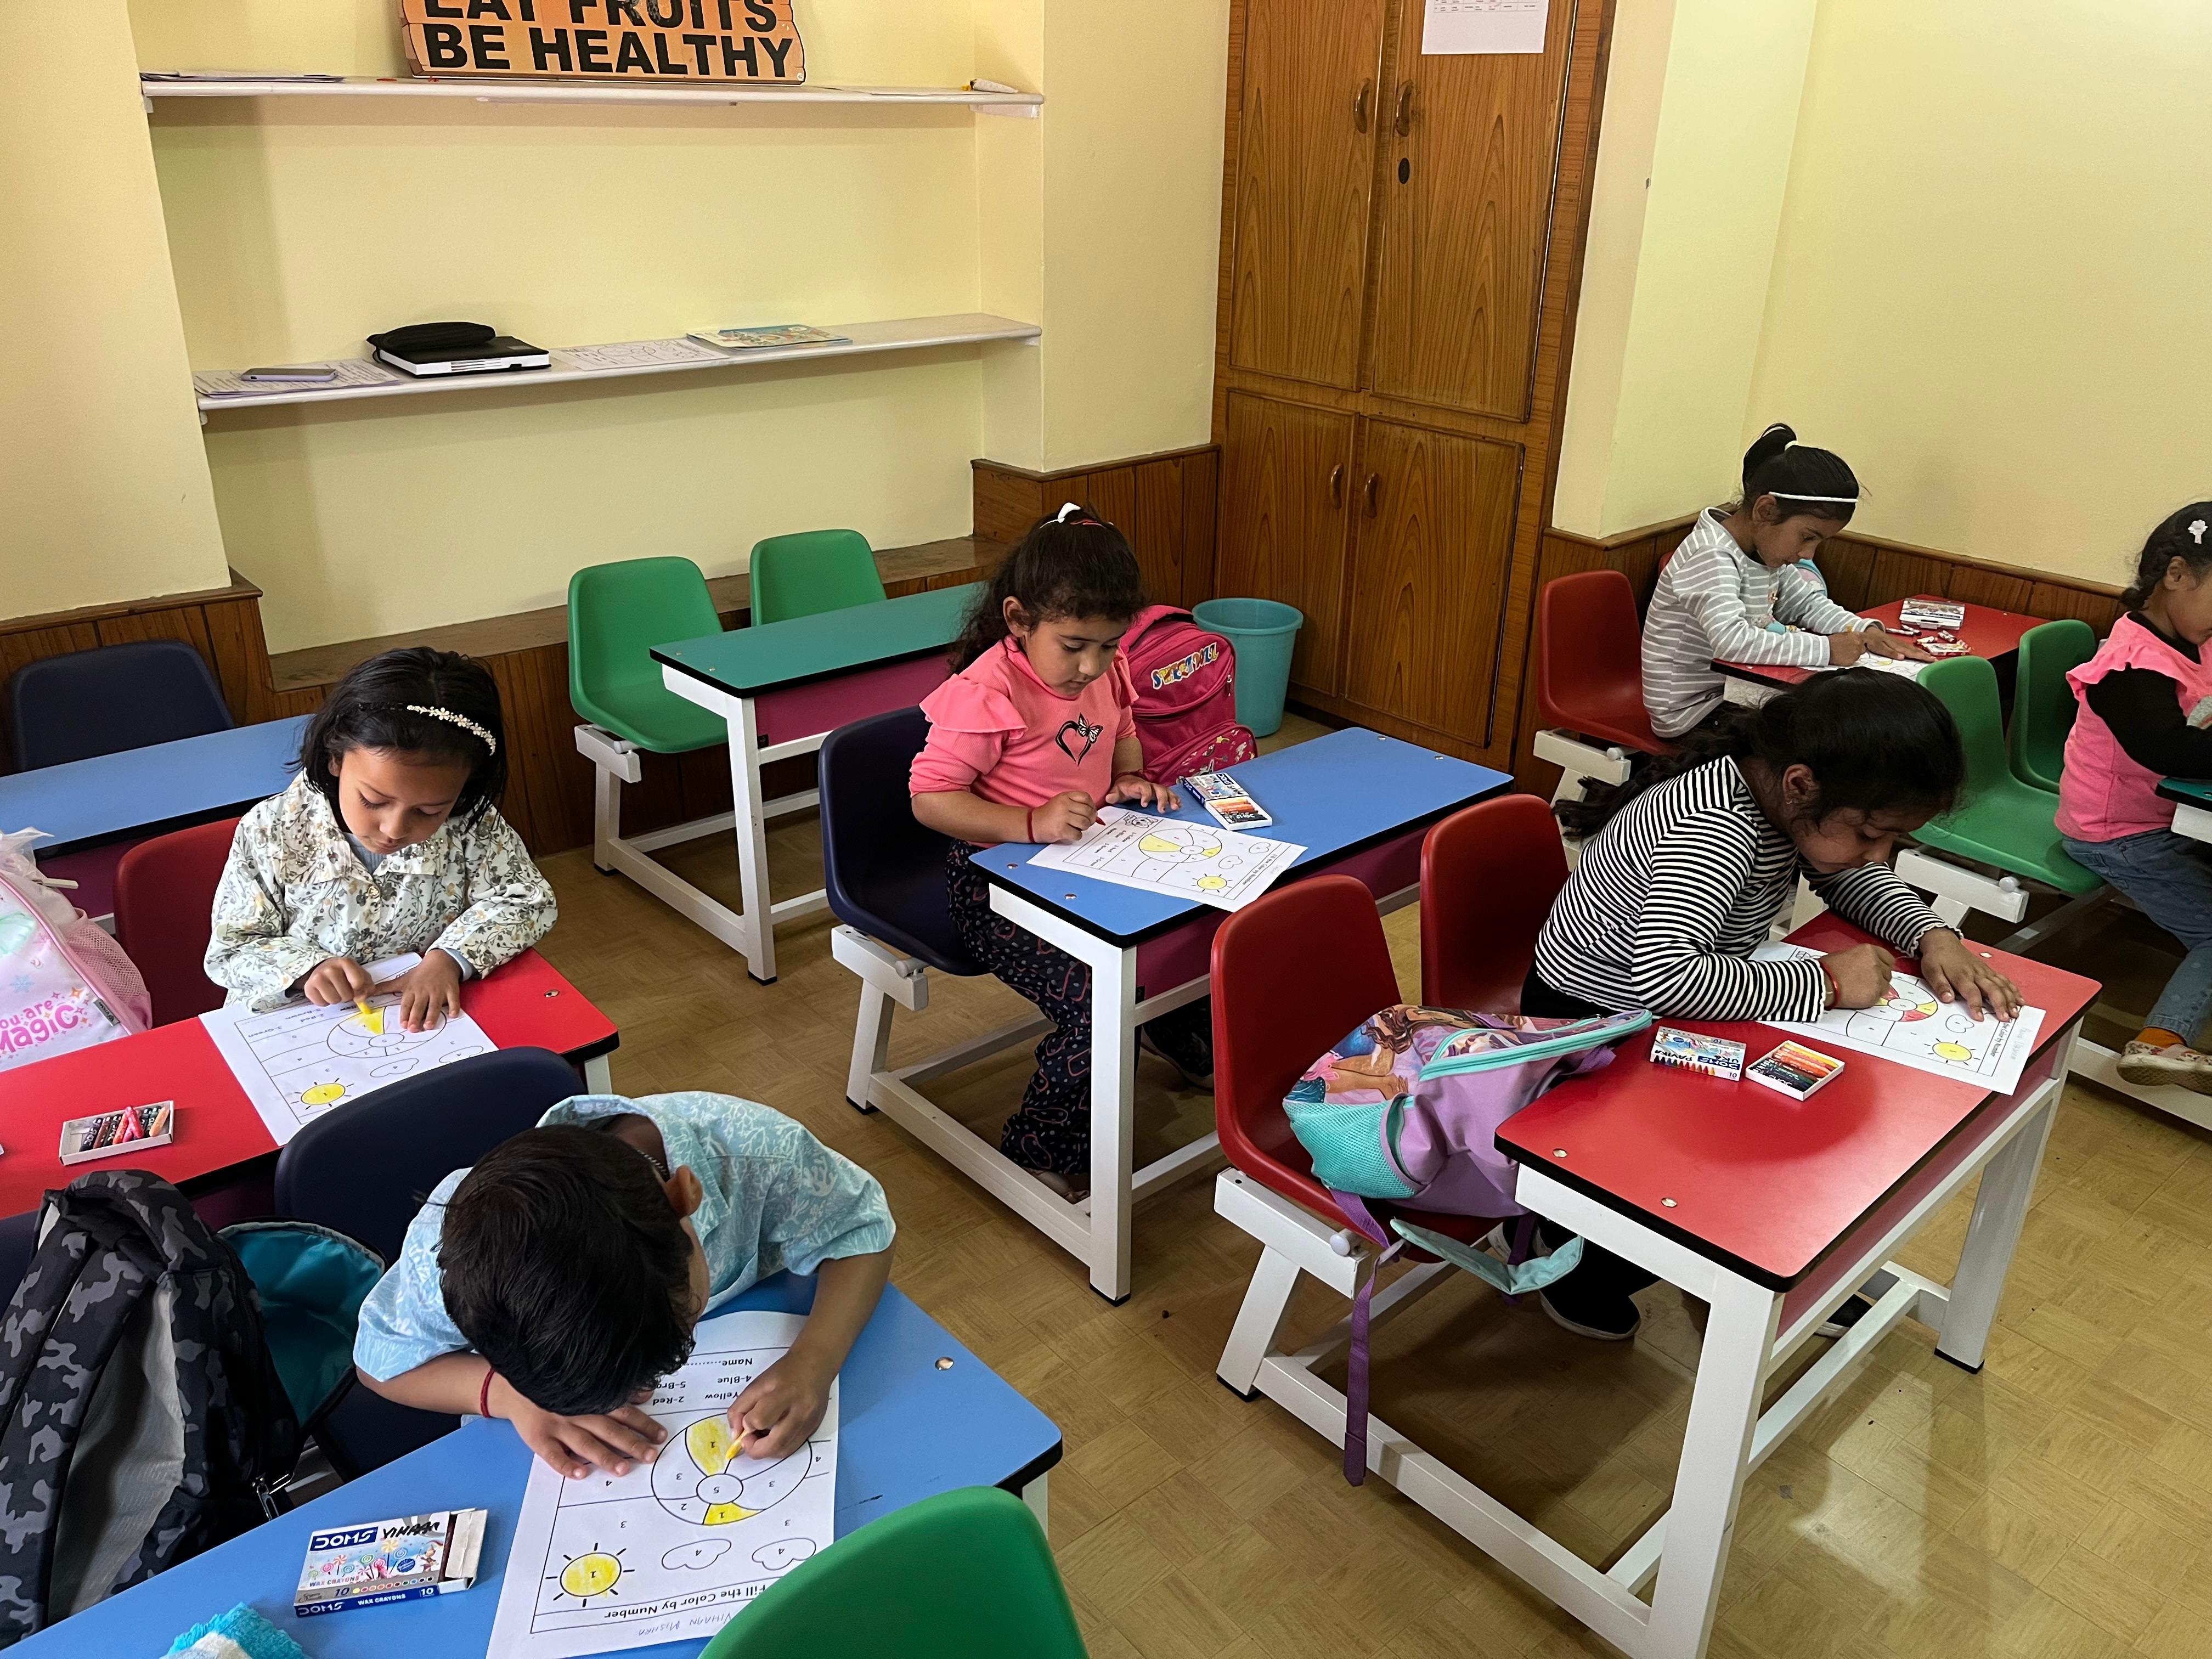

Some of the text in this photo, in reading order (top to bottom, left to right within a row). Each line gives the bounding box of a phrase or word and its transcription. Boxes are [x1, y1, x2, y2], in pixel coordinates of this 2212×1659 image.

[569, 0, 777, 32] FRUITS
[422, 24, 793, 77] BE HEALTHY
[0, 1000, 53, 1029] ou are
[1700, 1057, 1739, 1069] DOMS
[657, 1375, 752, 1389] 4-Blue 5-Bro
[653, 1391, 739, 1406] Yellow 2-Red
[314, 1530, 374, 1549] DOMS
[327, 1576, 359, 1585] CRAYONS
[335, 1587, 350, 1596] 10
[720, 1589, 741, 1599] the
[297, 1602, 343, 1615] DOMS
[375, 1594, 406, 1602] CRAYONS
[662, 1600, 676, 1610] by
[680, 1594, 716, 1606] Color
[604, 1605, 658, 1618] Number
